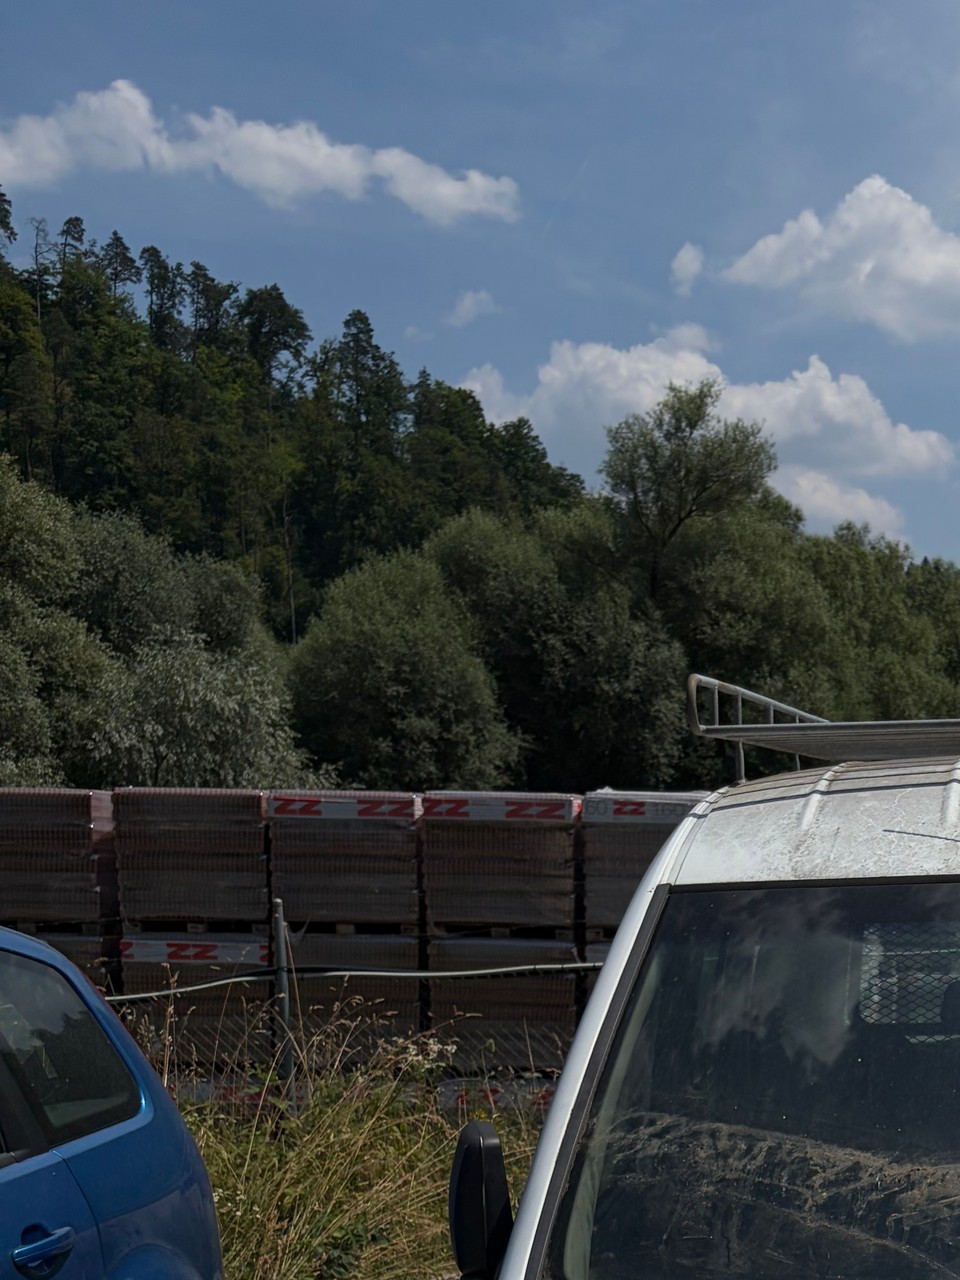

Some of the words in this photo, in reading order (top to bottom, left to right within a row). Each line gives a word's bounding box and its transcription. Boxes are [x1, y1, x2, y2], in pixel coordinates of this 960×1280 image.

[272, 796, 322, 817] ZZ
[356, 799, 415, 819] ZZ
[424, 798, 470, 818] ZZ
[505, 800, 566, 820] ZZ
[613, 800, 646, 816] ZZ
[166, 942, 219, 961] ZZ
